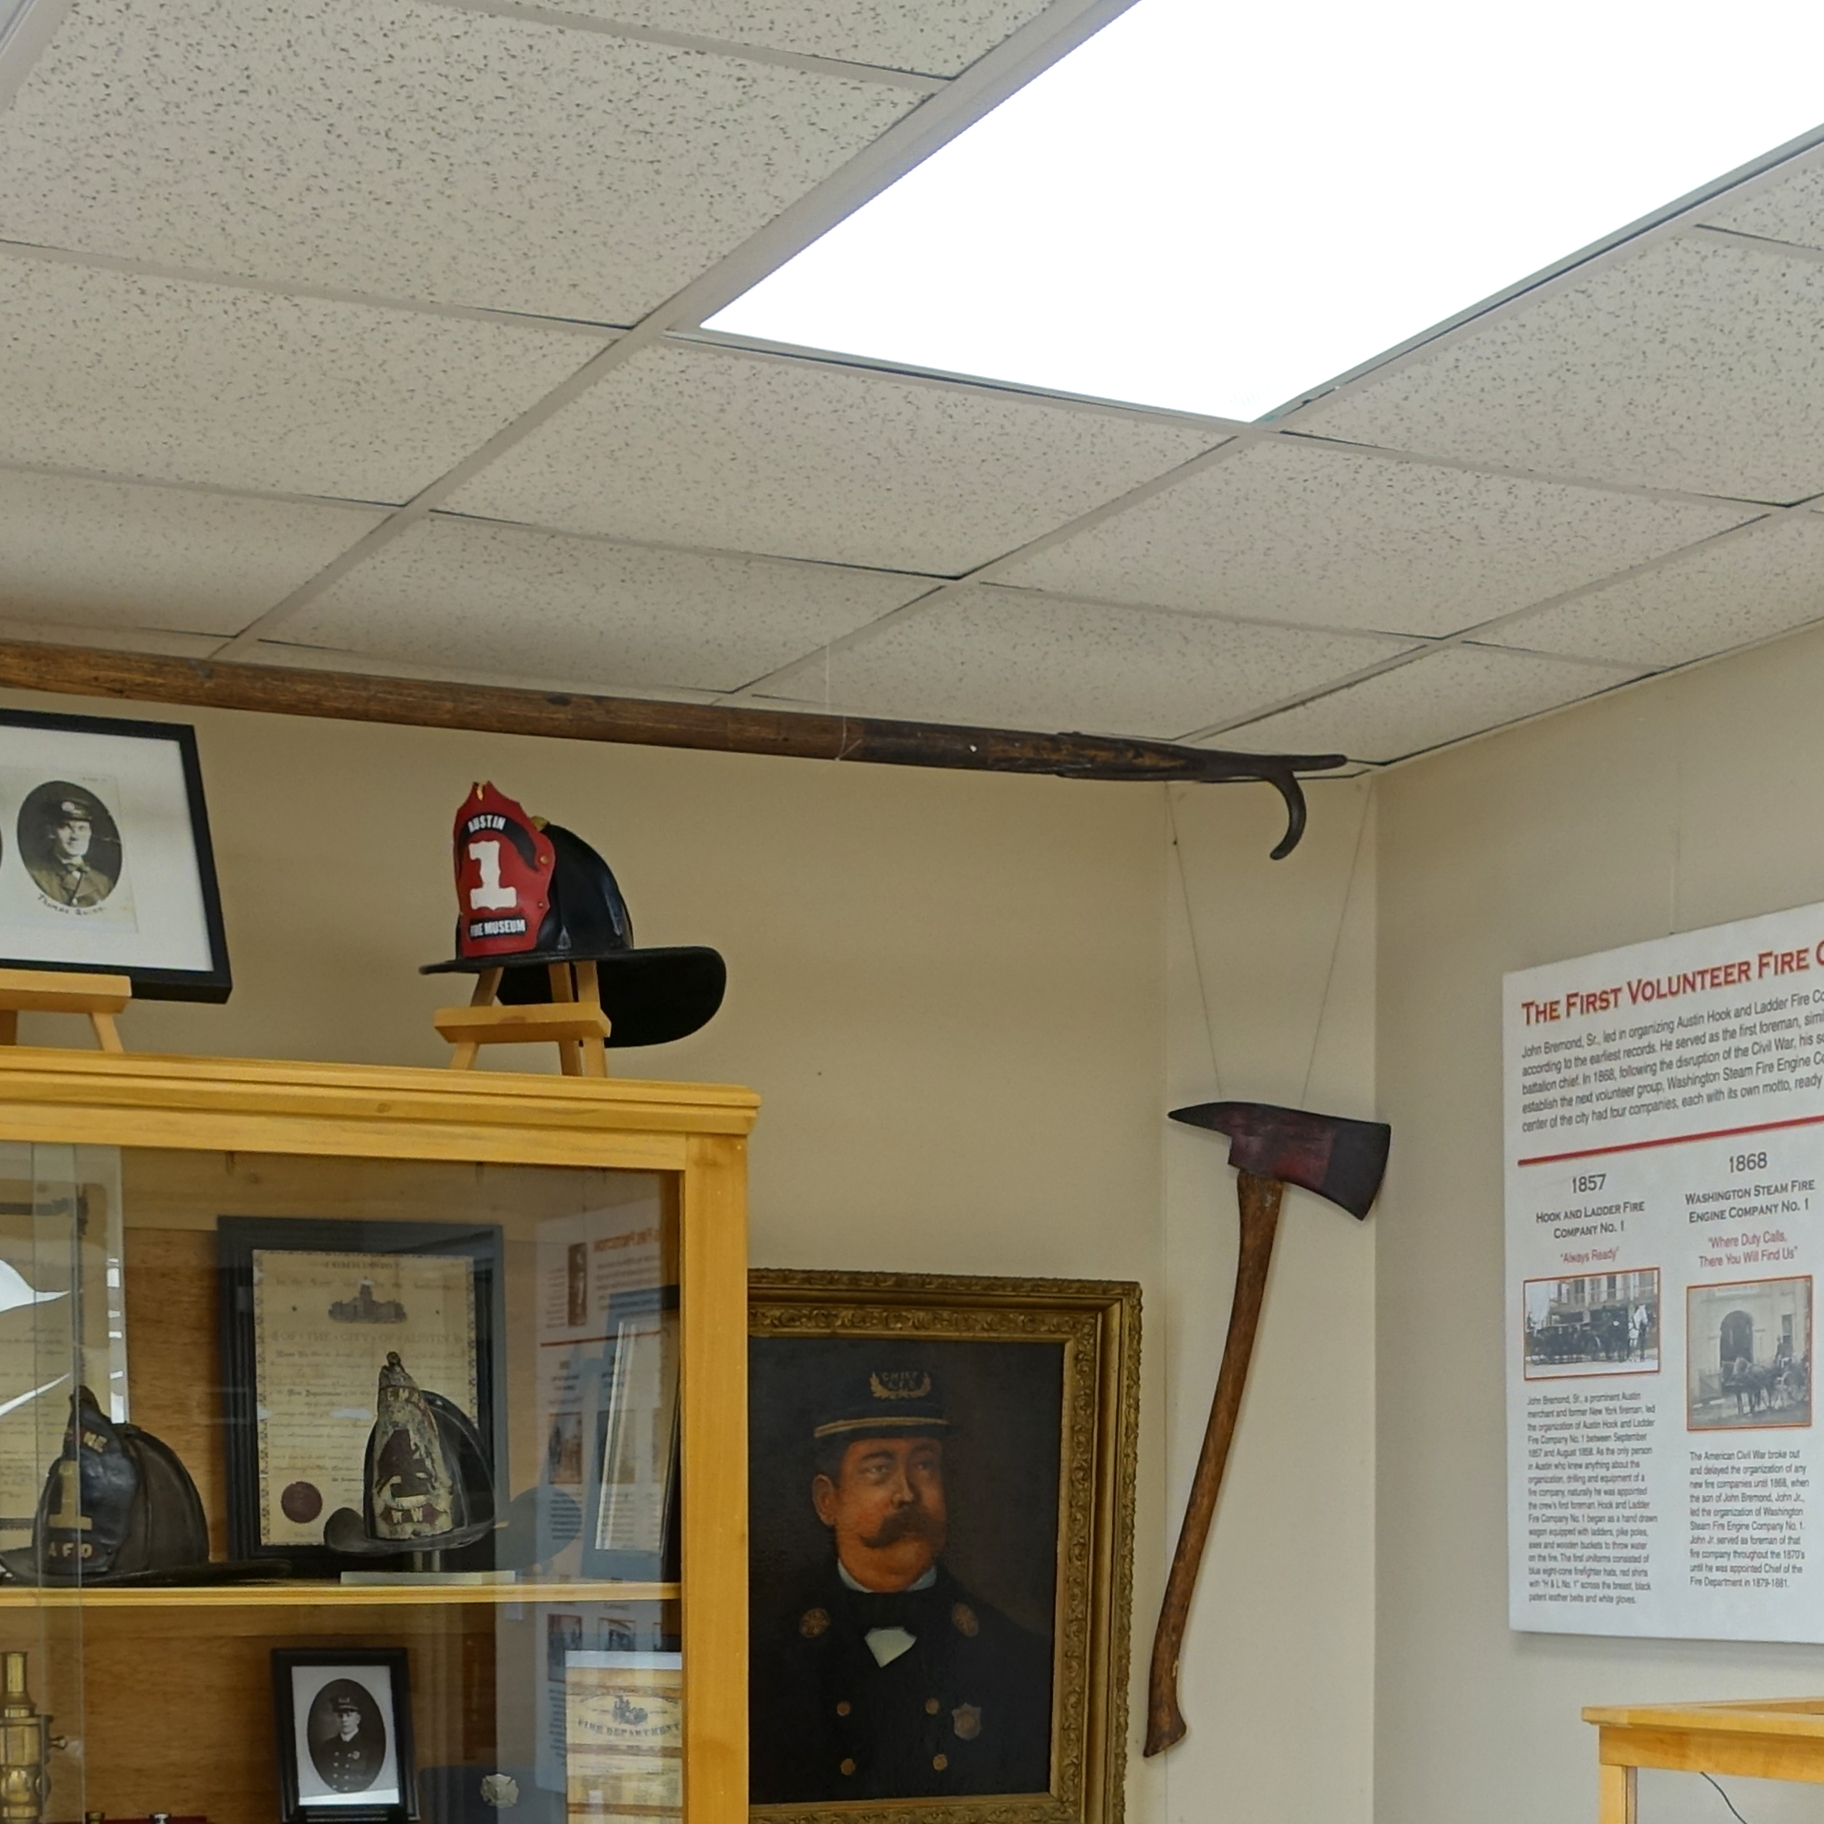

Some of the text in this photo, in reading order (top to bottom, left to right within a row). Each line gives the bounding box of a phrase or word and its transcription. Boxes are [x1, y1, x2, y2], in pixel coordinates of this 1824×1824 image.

[468, 815, 506, 833] AUSTIN
[468, 840, 517, 910] 1
[484, 918, 526, 935] MUSEUM
[1521, 999, 1562, 1026] THE
[1565, 986, 1623, 1018] FIRST
[1626, 960, 1752, 1005] VOLUNTEER
[1757, 947, 1811, 980] FIRE
[1729, 1151, 1768, 1173] 1868
[1572, 1173, 1607, 1194] 1857
[1684, 1179, 1816, 1206] WASHINGTON STEAM FIRE
[1535, 1200, 1645, 1224] HOOK AND LADDER FIRE
[1688, 1197, 1809, 1224] ENGINE COMPANY NO. 1
[1553, 1219, 1625, 1240] COMPANY NO. 1
[1740, 1232, 1762, 1248] Duty
[1698, 1255, 1724, 1268] There
[1725, 1253, 1742, 1265] You
[1742, 1250, 1760, 1264] Will
[1760, 1248, 1781, 1262] Find
